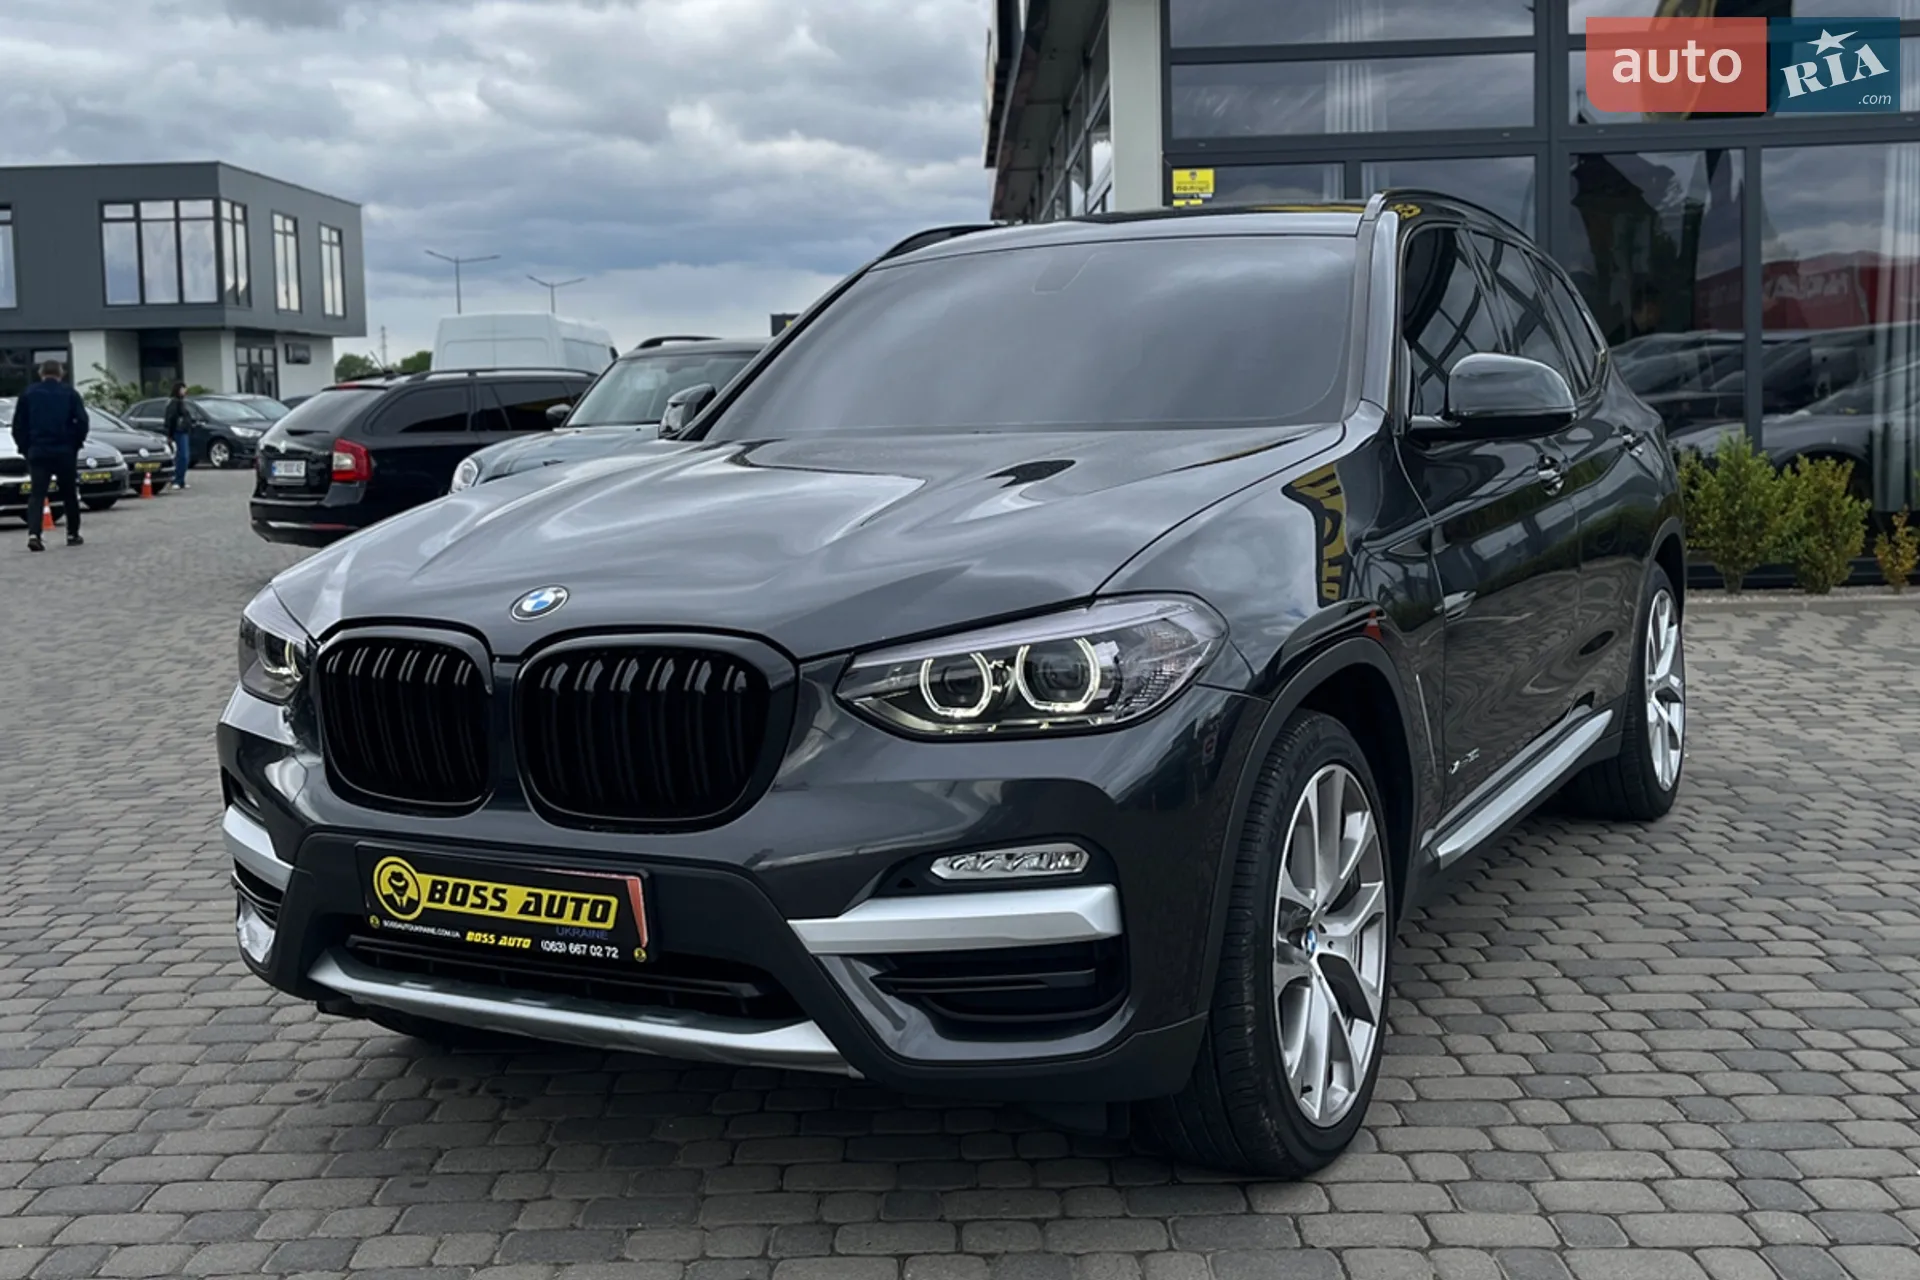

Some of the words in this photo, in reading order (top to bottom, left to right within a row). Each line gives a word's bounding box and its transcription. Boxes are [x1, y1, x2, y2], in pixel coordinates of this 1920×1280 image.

[427, 879, 508, 913] BOSS
[517, 891, 613, 923] AUTO
[465, 931, 496, 945] BOSS
[498, 936, 532, 949] AUTO
[556, 925, 609, 940] UKRAINE
[541, 940, 567, 953] (063)
[568, 943, 587, 955] 667
[590, 945, 603, 957] 02
[605, 946, 619, 959] 72
